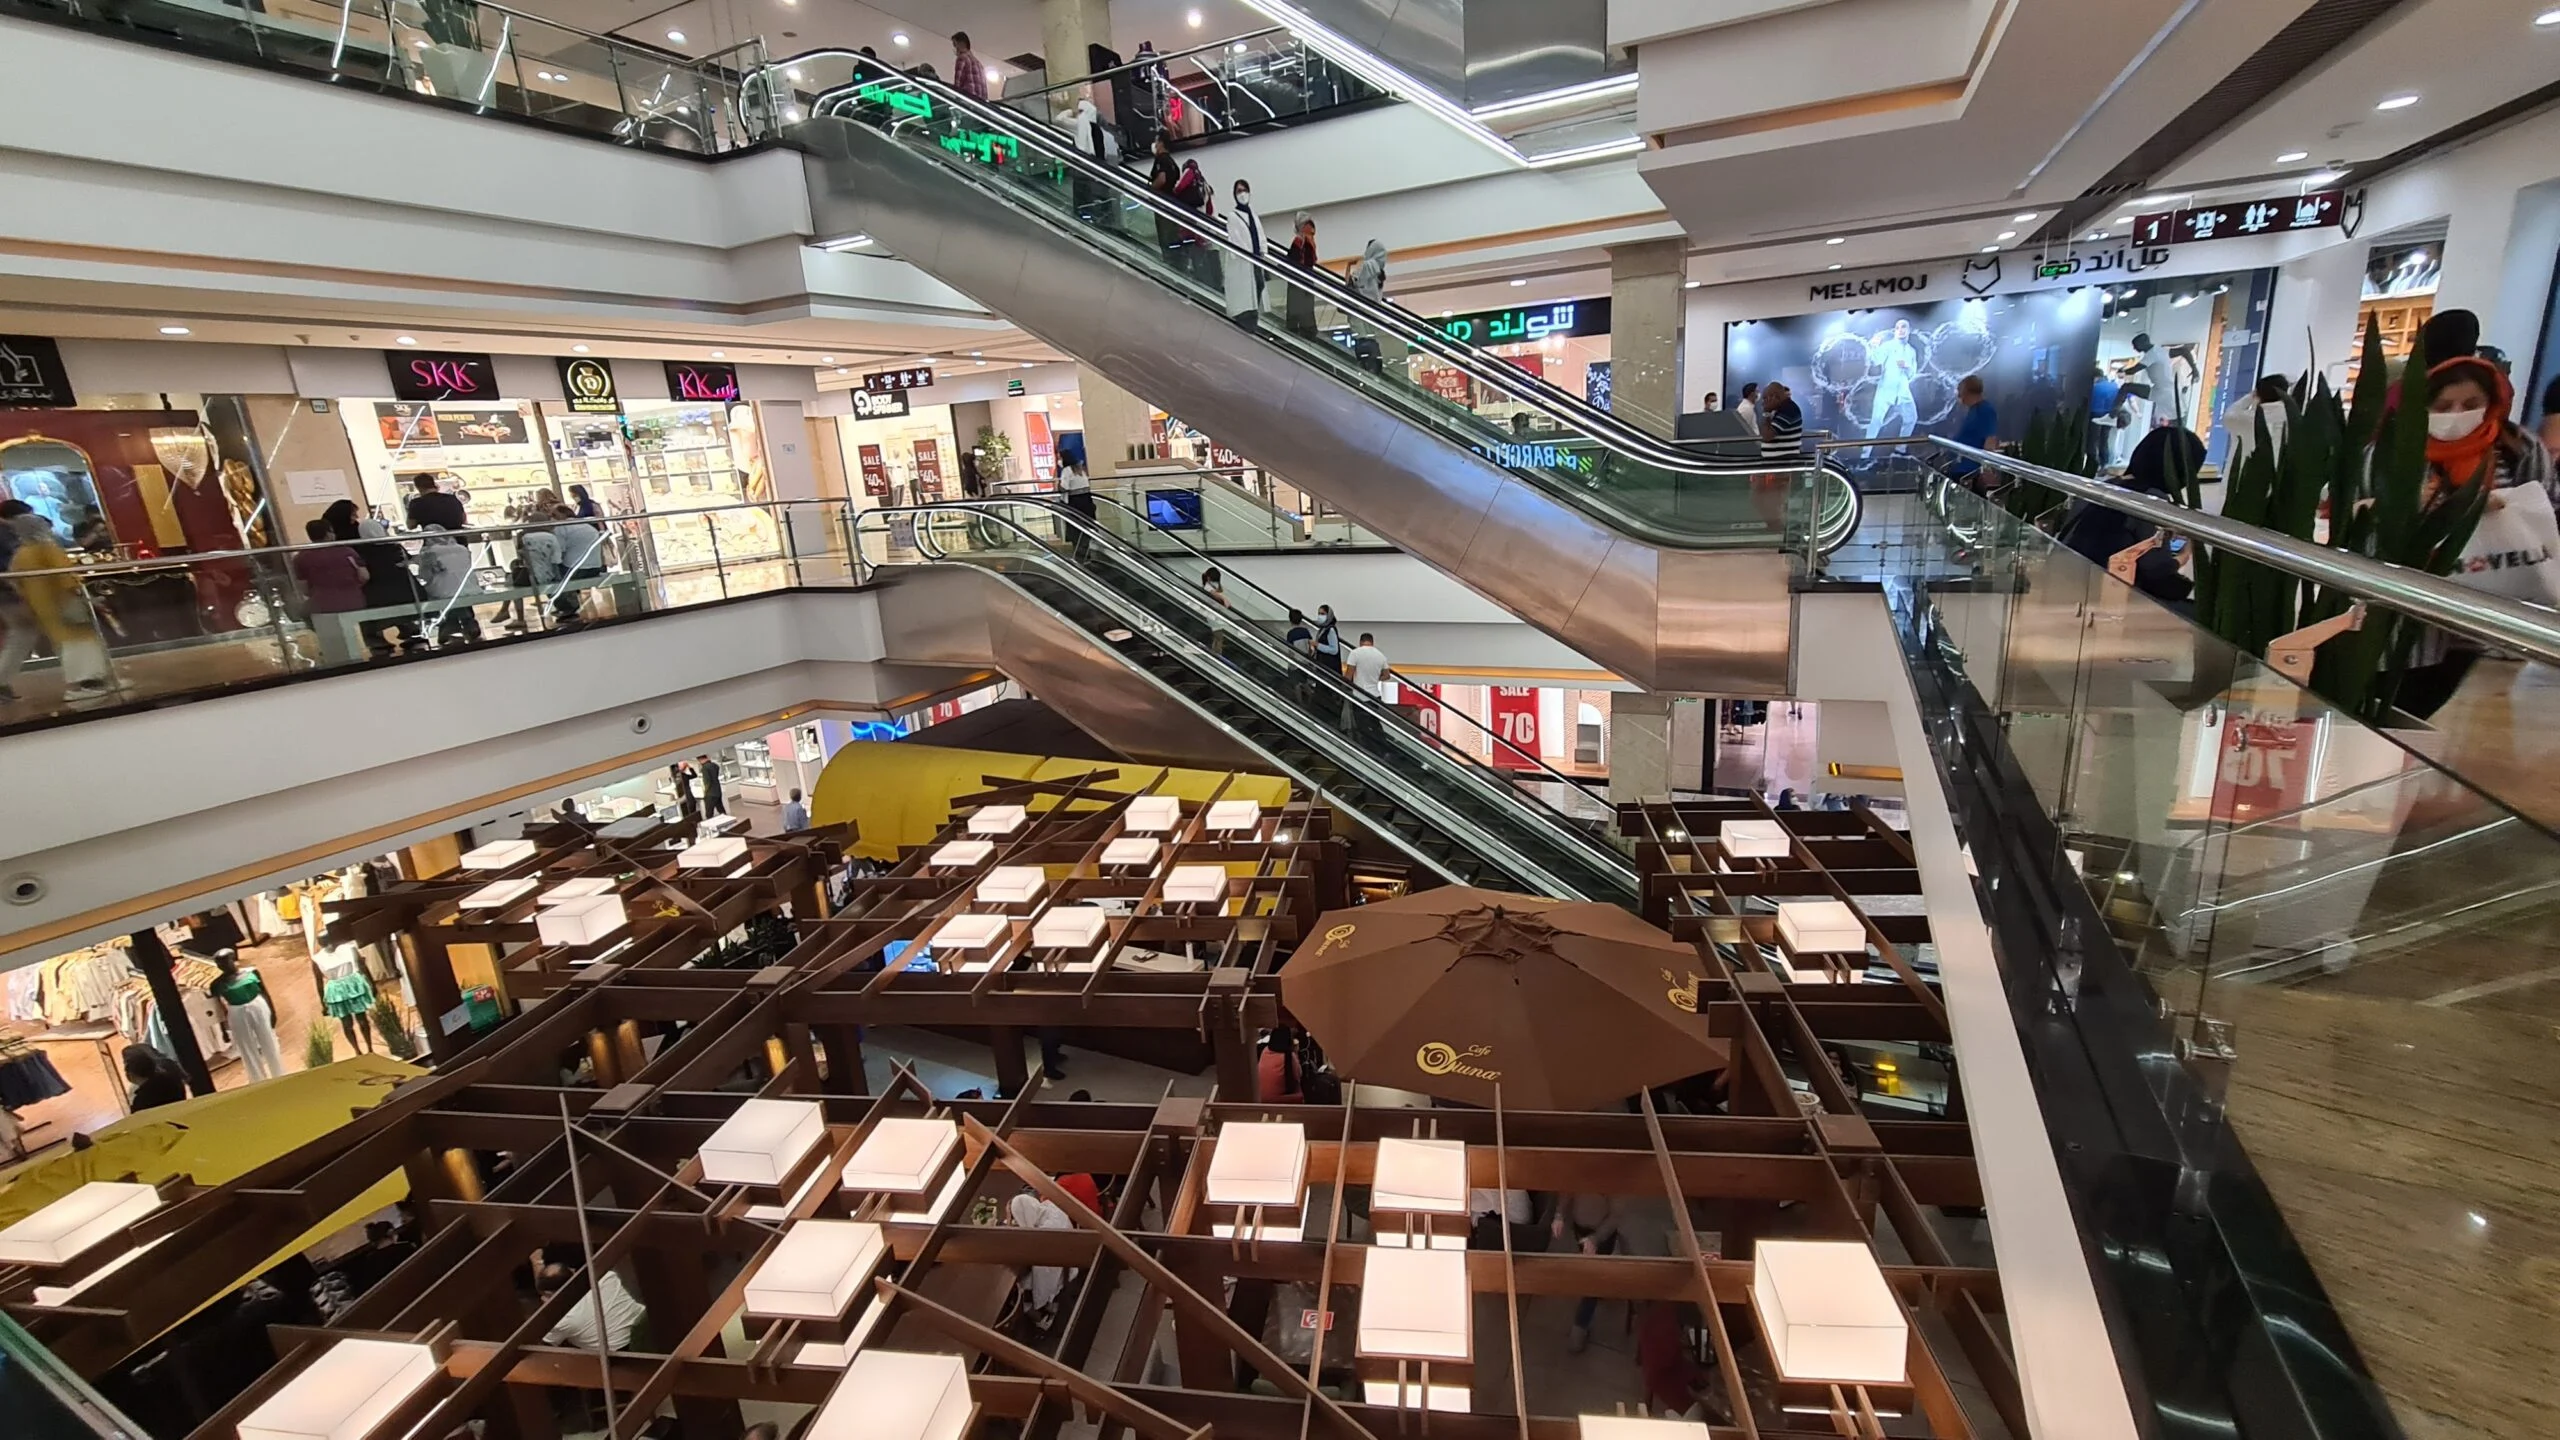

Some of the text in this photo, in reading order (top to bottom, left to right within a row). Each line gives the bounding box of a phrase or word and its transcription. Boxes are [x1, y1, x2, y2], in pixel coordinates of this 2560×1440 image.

[2147, 220, 2159, 240] 1
[1810, 274, 1928, 301] MEL&MOJ
[411, 360, 478, 392] SKK
[862, 455, 881, 466] SALE
[918, 451, 937, 461] SALE
[1500, 686, 1530, 697] SALE
